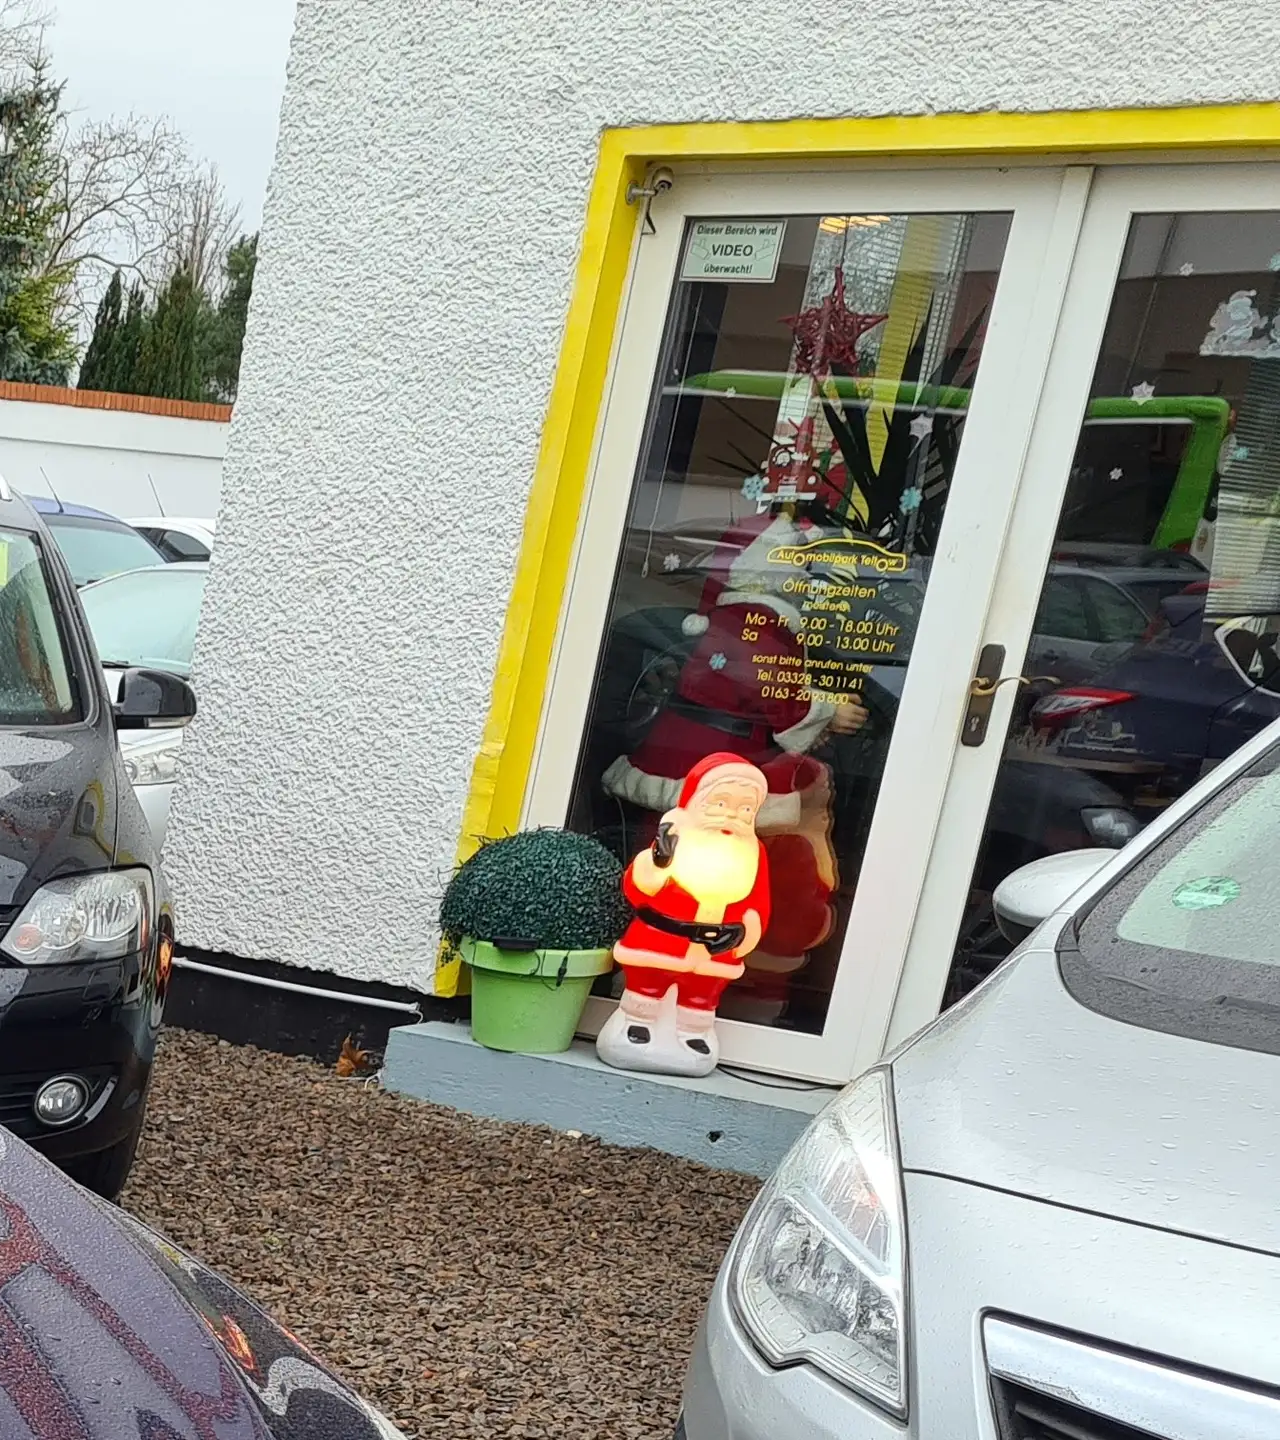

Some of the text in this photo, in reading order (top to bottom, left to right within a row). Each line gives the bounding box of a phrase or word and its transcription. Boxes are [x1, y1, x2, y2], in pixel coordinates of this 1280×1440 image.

[696, 224, 778, 235] Dieser Bereich wird
[711, 243, 754, 257] VIDEO
[703, 263, 753, 274] überwacht!
[745, 612, 767, 626] Mo
[777, 613, 791, 627] Fr
[799, 616, 827, 630] 9.00
[840, 619, 873, 634] 18.00
[876, 622, 900, 636] Uhr
[741, 628, 759, 642] Sa
[796, 633, 824, 647] 9.00
[836, 637, 870, 651] 13.00
[872, 639, 896, 653] Uhr
[752, 654, 873, 674] sonst bitte anrufen unter
[757, 669, 774, 682] Tel.
